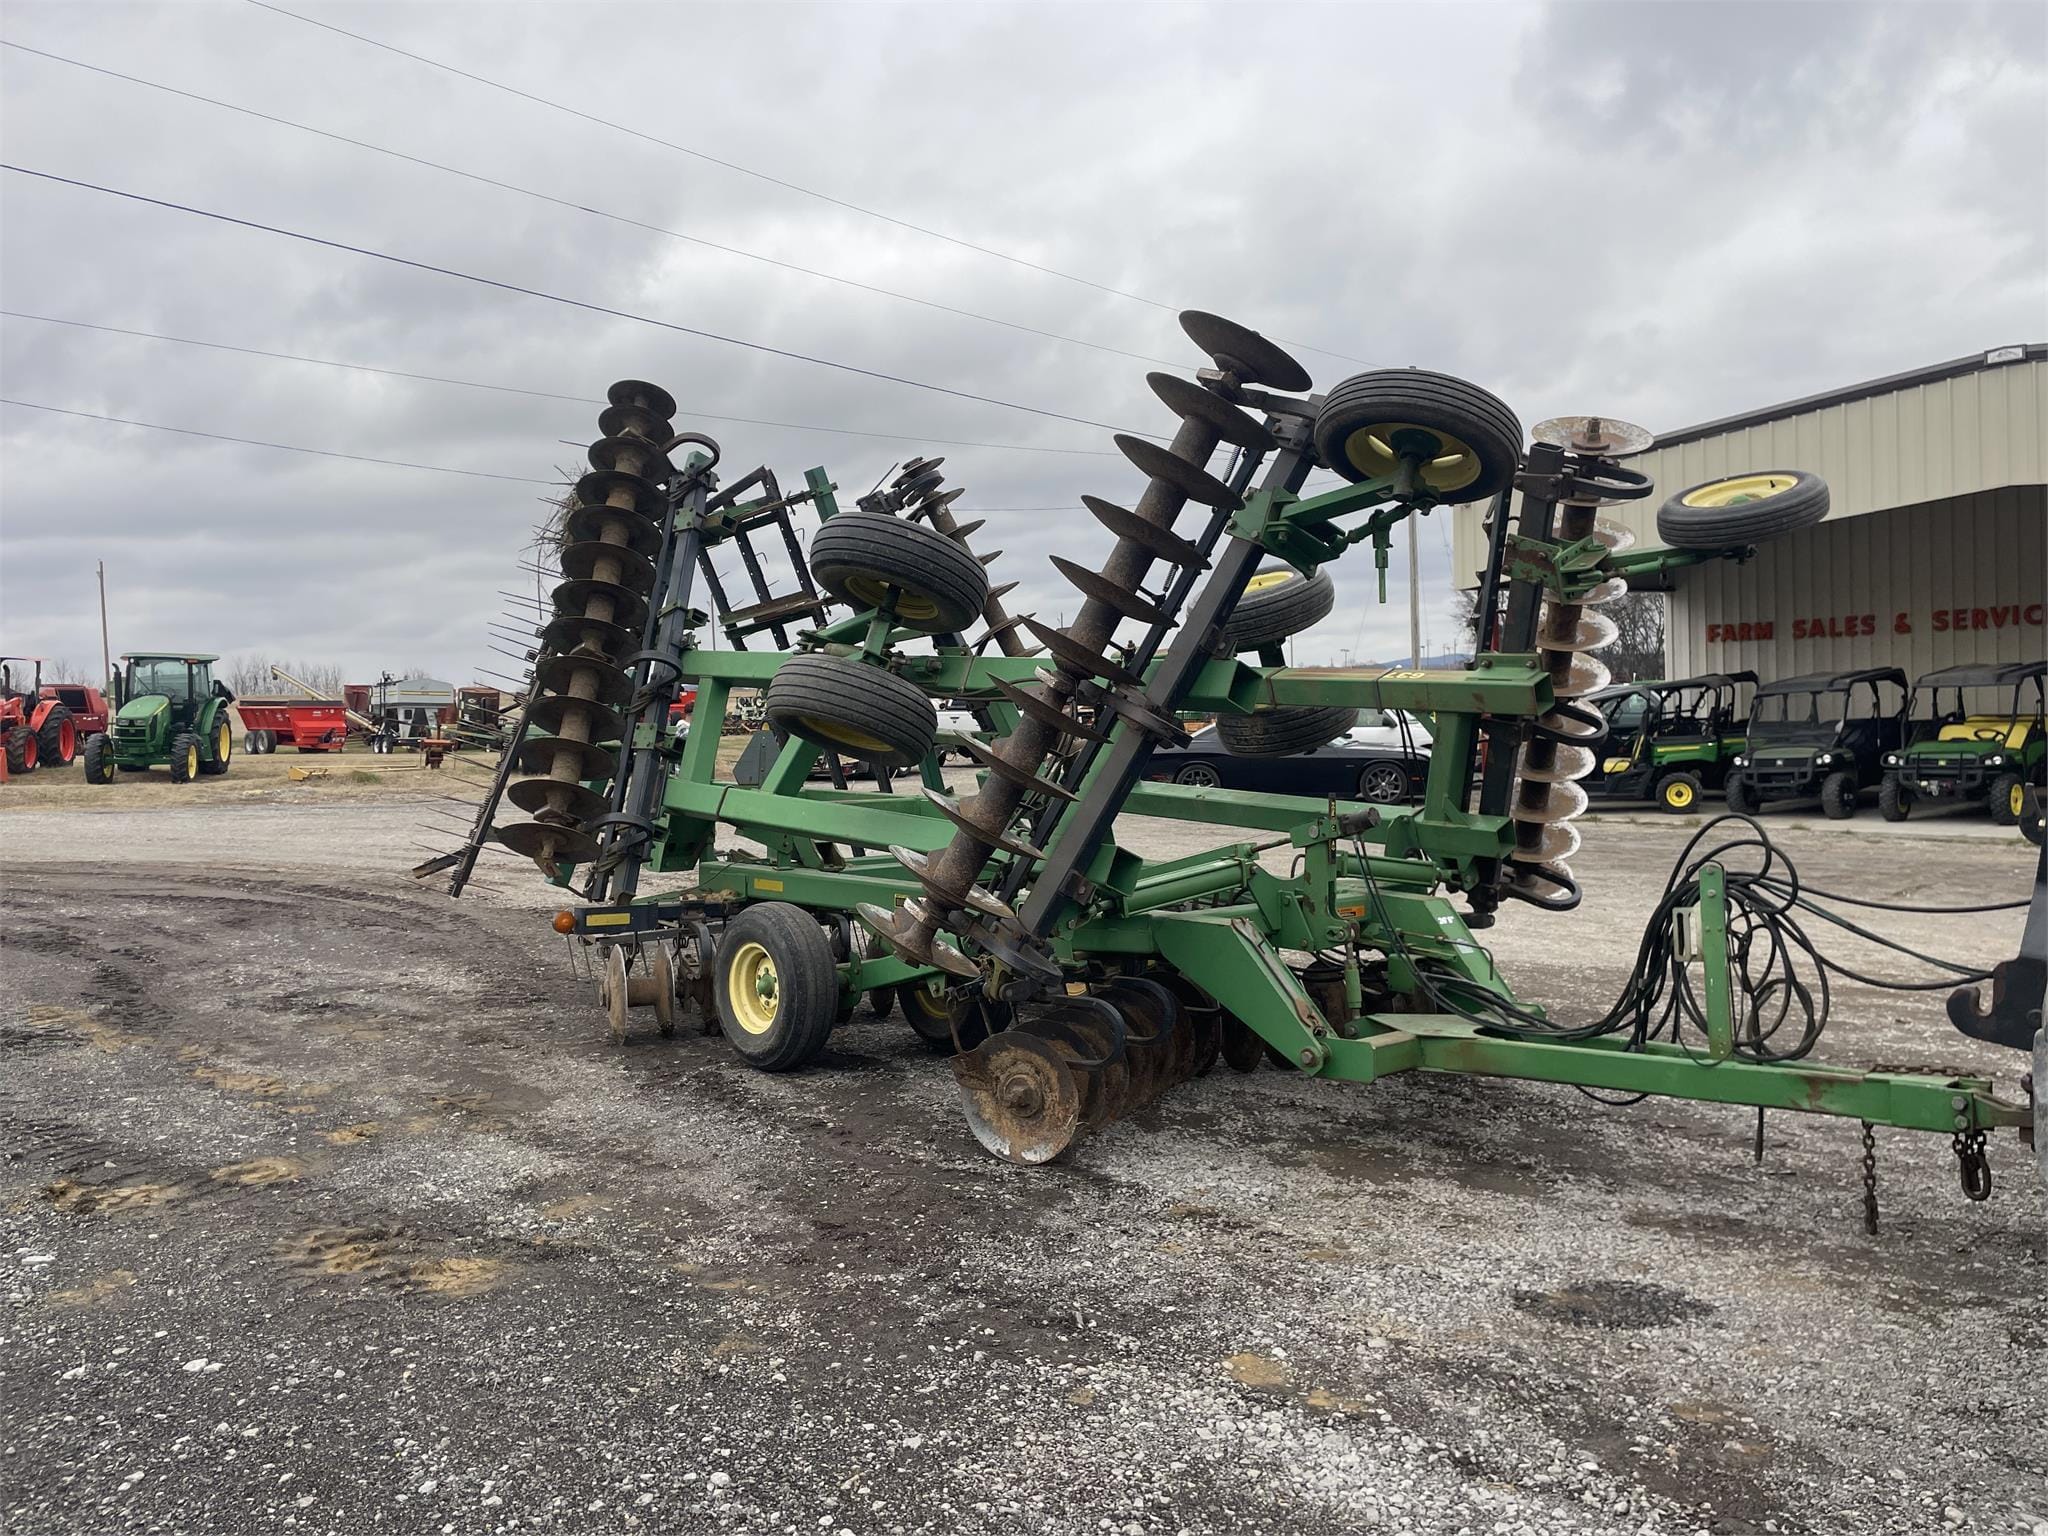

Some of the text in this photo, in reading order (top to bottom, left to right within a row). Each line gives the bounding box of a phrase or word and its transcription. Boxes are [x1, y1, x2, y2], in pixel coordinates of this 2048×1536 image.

[1706, 604, 2048, 643] FARM SALES & SERVIC
